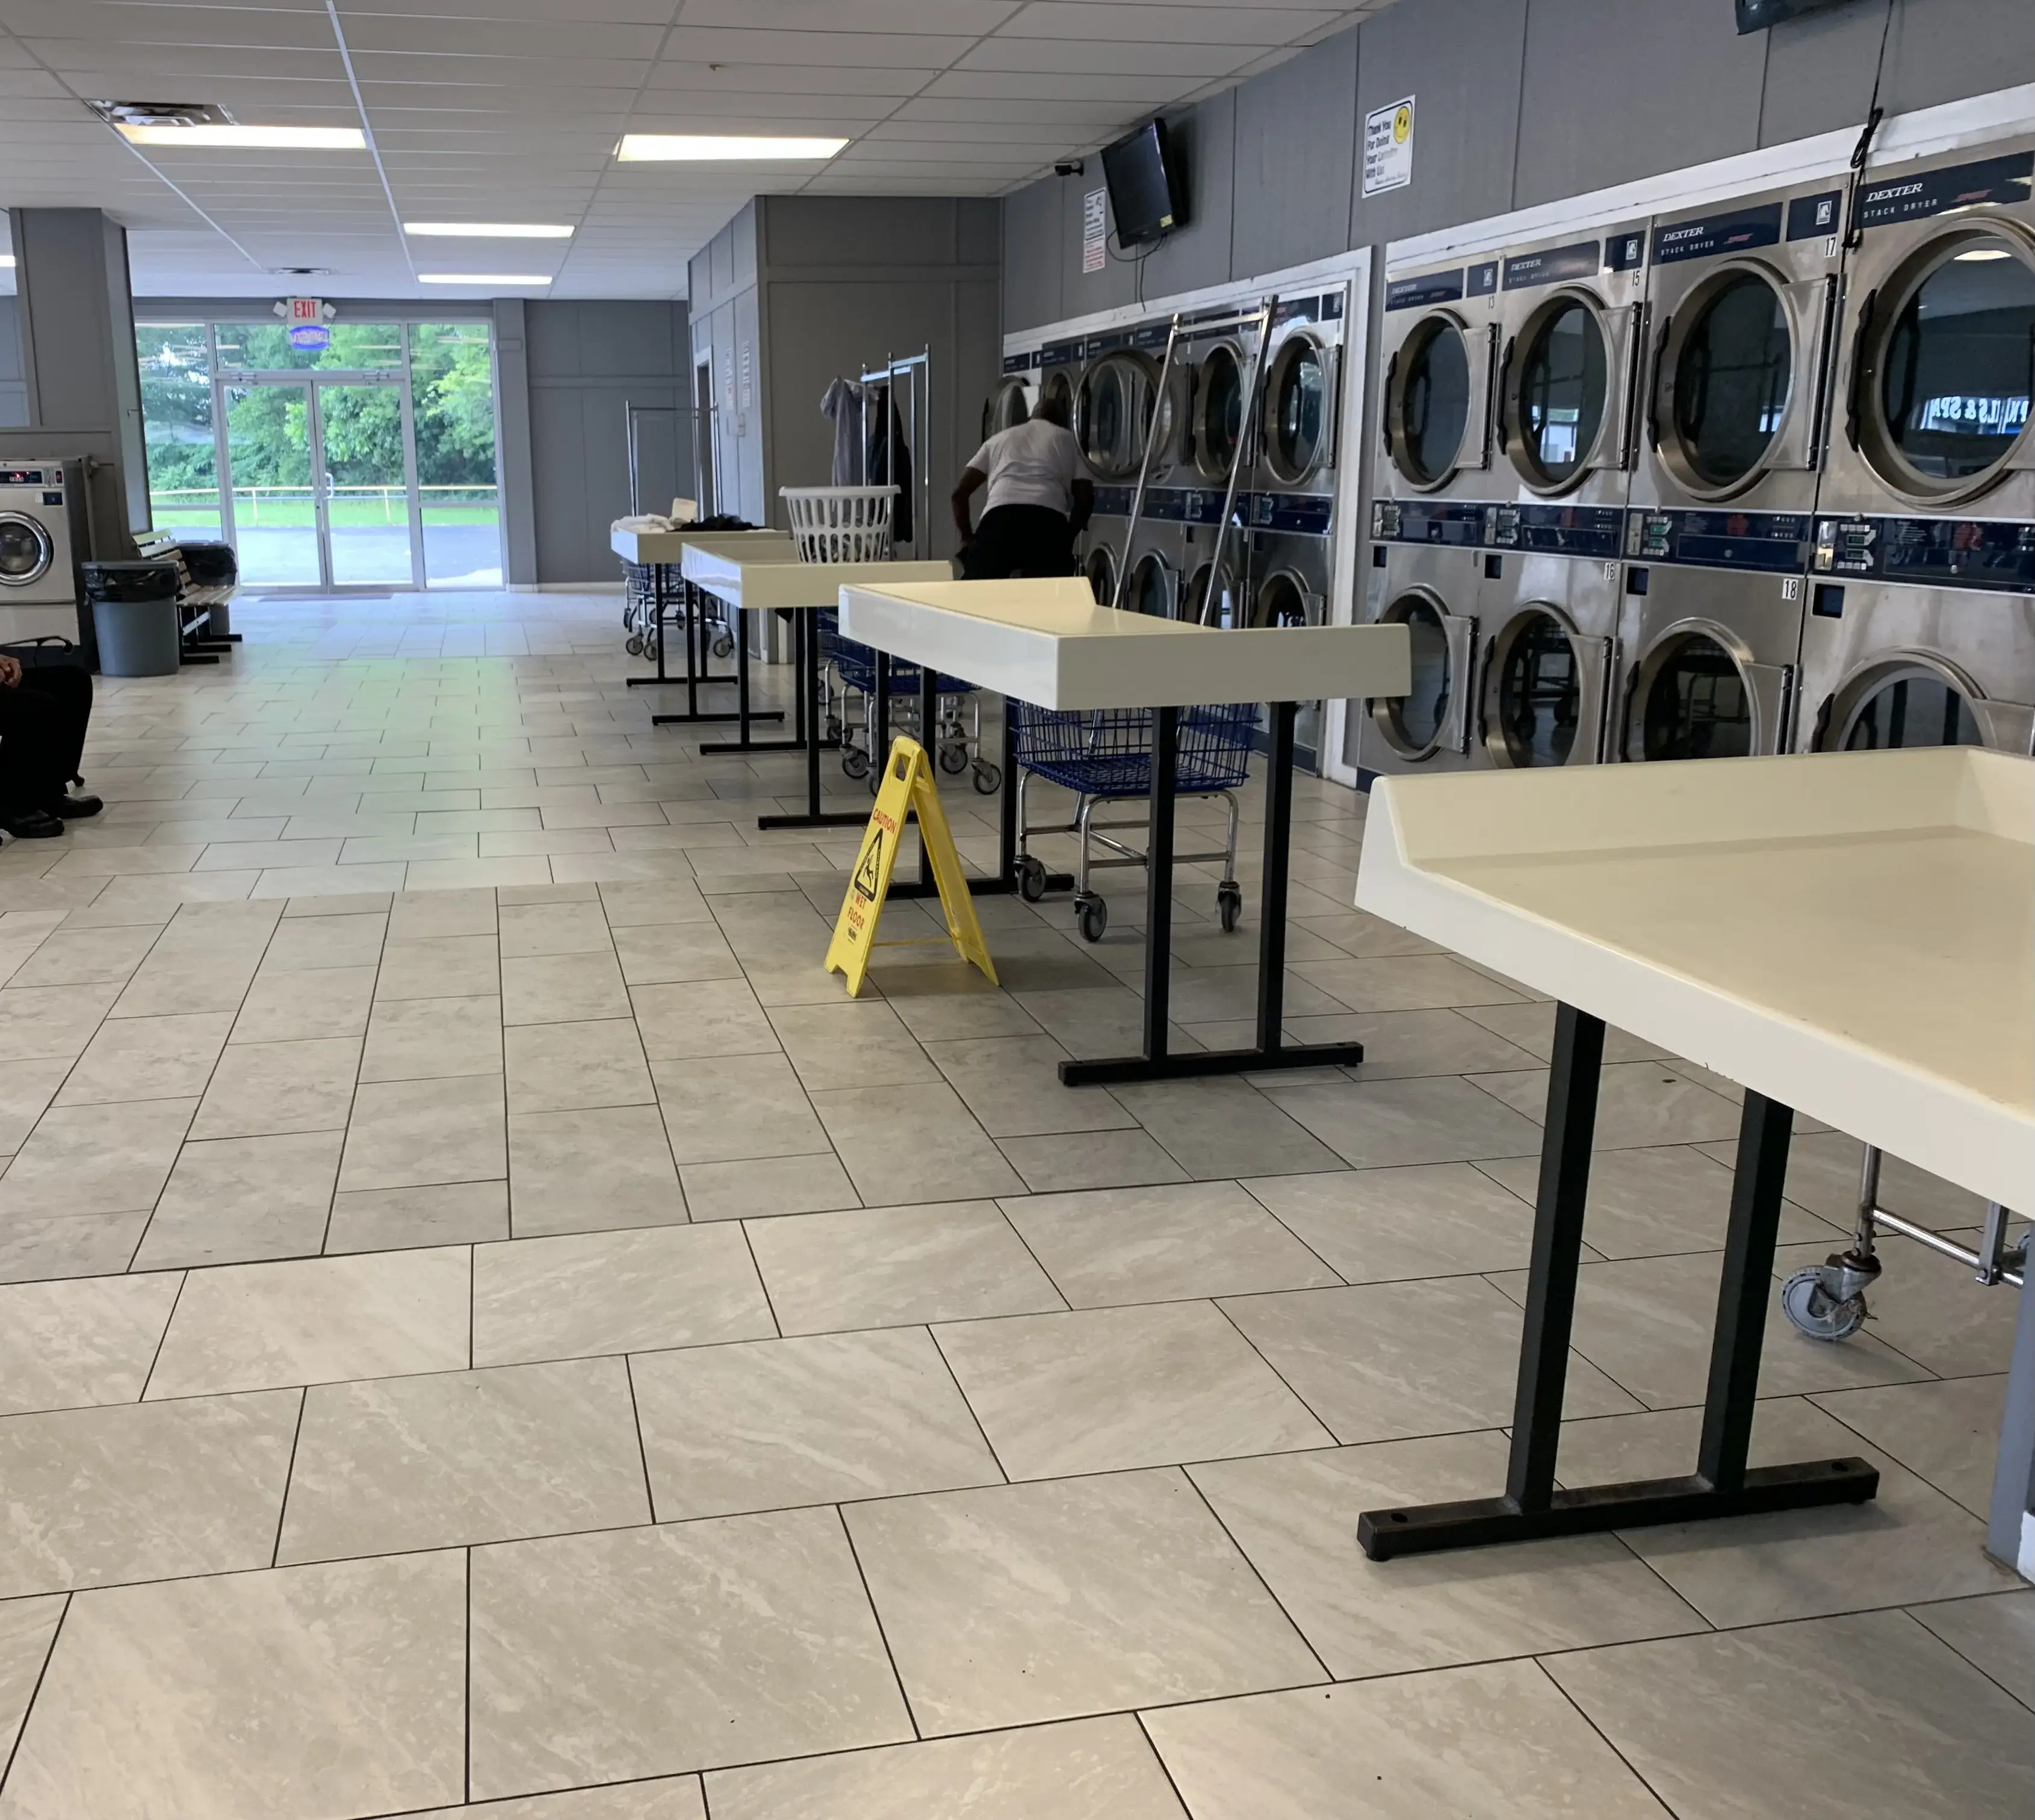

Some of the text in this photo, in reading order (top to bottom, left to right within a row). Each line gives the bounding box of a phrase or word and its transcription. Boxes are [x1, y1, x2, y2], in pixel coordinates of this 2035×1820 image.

[1866, 182, 1923, 202] DEXTER
[1863, 199, 1938, 219] STACK DRYER
[1663, 226, 1704, 243] DEXTER
[1661, 247, 1685, 256] STACK
[1826, 237, 1836, 256] 17
[1510, 258, 1541, 272] DEXTER
[1632, 270, 1640, 287] 15
[294, 300, 316, 318] EXIT
[1606, 563, 1614, 580] 16
[1785, 580, 1797, 599] 18
[873, 808, 897, 834] CAUTION
[855, 893, 867, 910] WET
[847, 906, 865, 930] FLOOR
